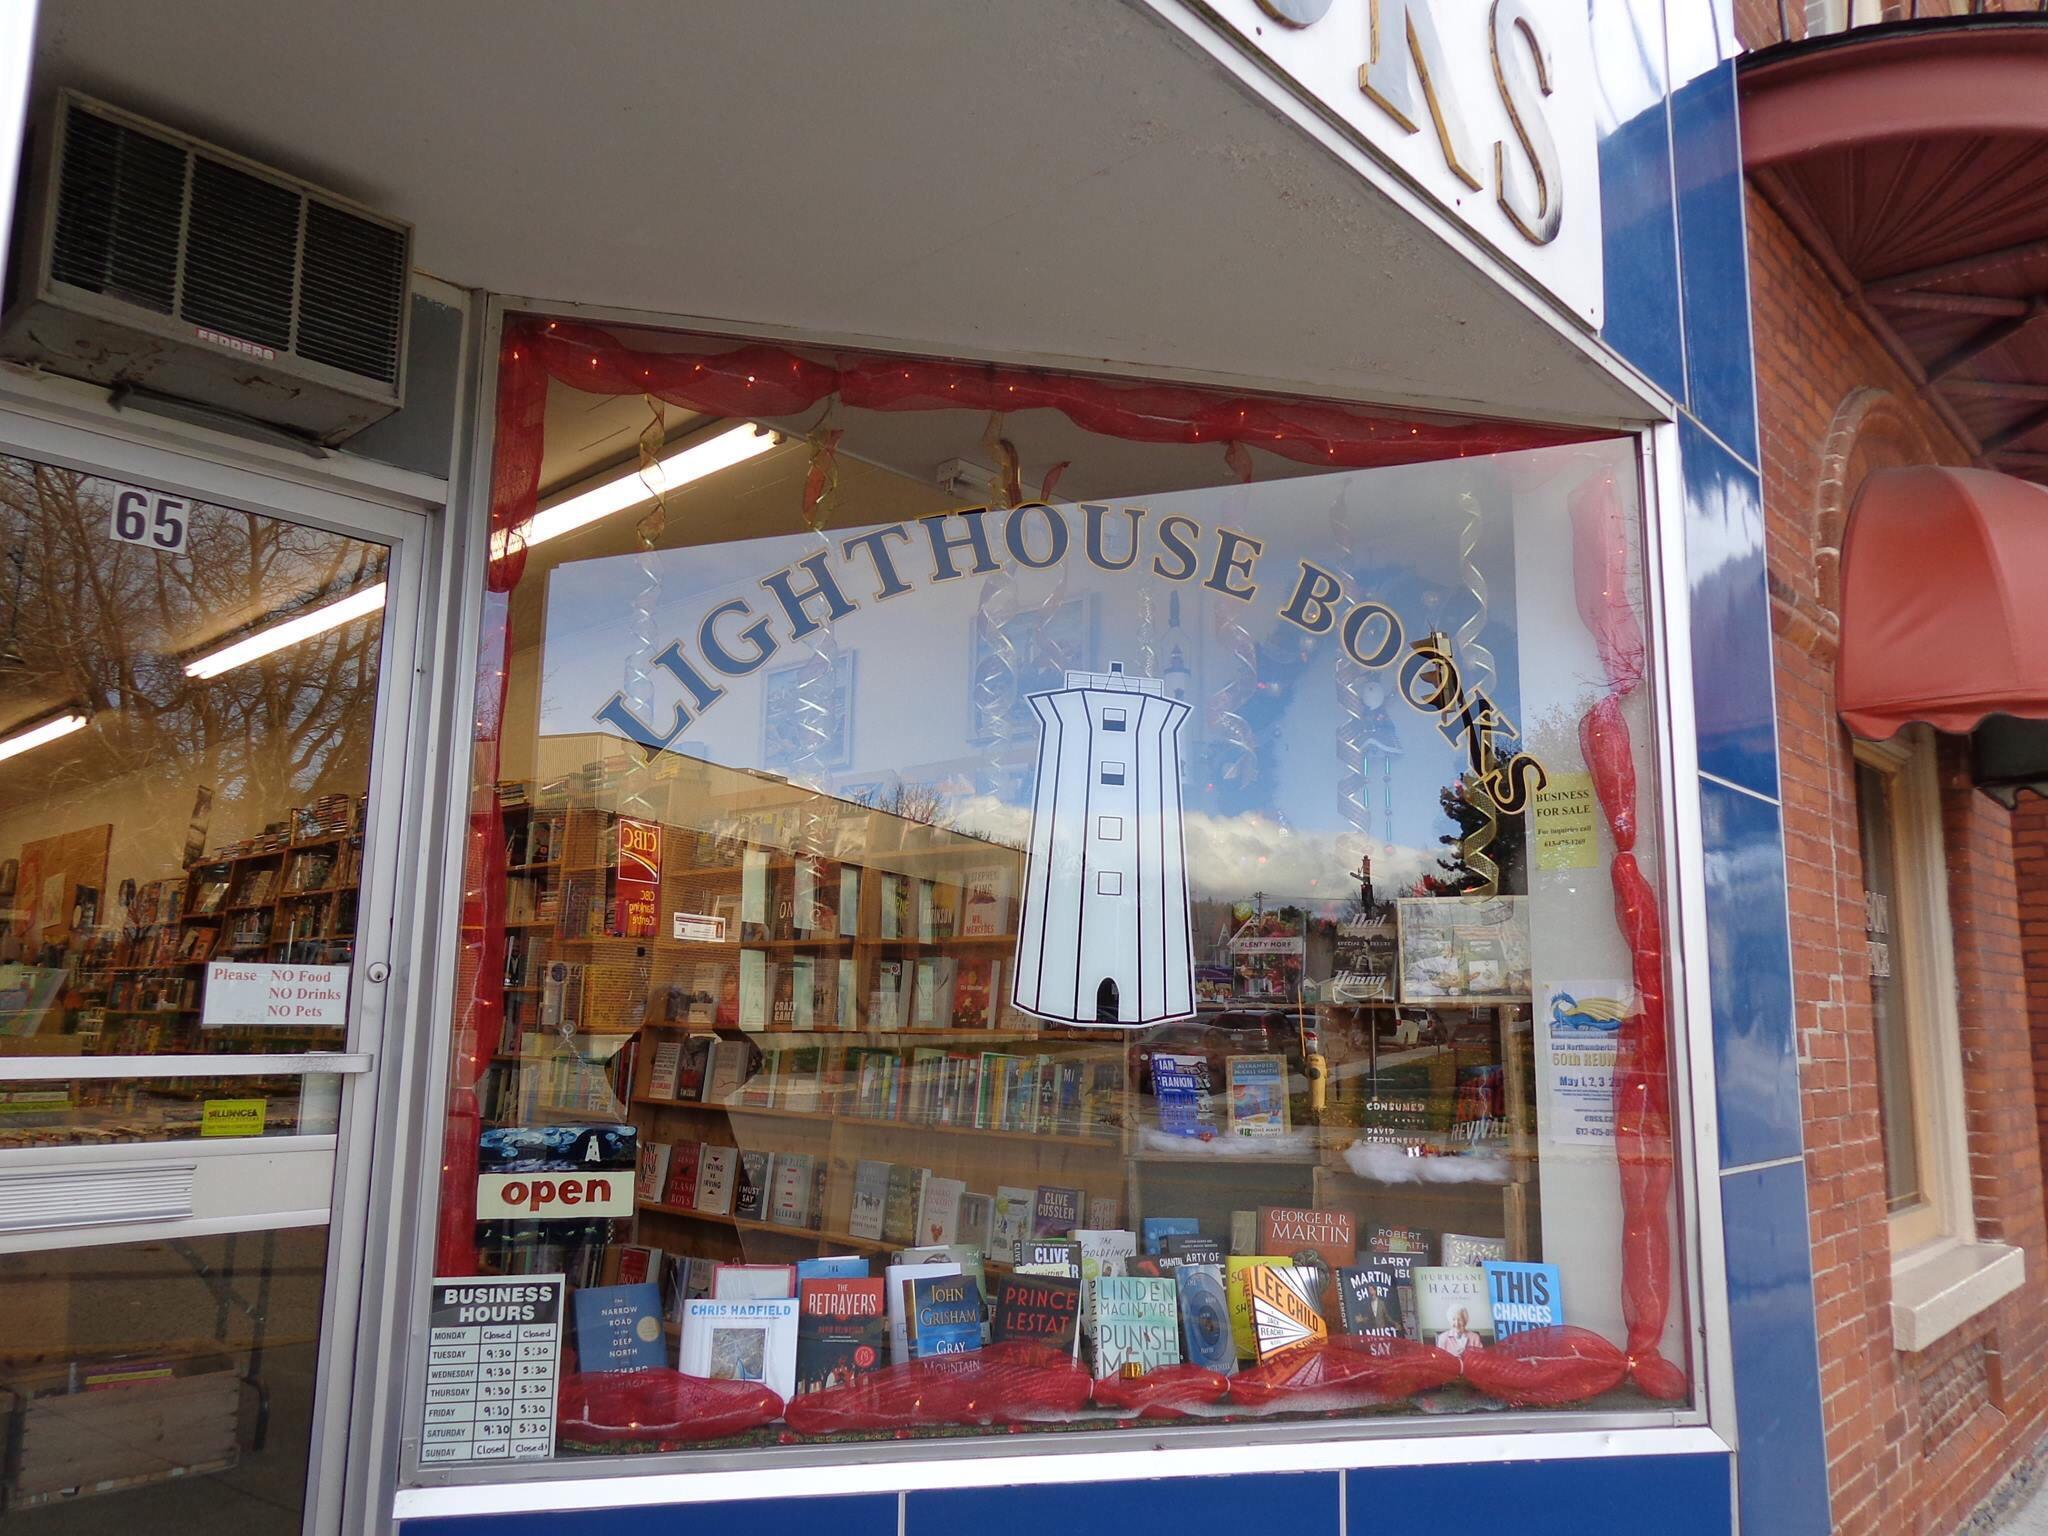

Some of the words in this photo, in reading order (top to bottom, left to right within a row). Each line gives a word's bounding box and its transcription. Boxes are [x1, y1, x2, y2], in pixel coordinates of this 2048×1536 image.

[1252, 0, 1563, 246] KS
[197, 329, 274, 360] FEDDERS
[116, 491, 183, 548] 65
[593, 500, 1264, 766] LIGHTHOUSE
[1279, 558, 1548, 815] BOOKS
[1536, 789, 1590, 802] BUSINESS
[1536, 807, 1559, 817] FOR
[1562, 804, 1591, 815] SALE
[974, 883, 993, 896] KING
[213, 968, 257, 981] Please
[270, 969, 294, 982] NO
[299, 970, 331, 983] Food
[1334, 970, 1386, 989] Young
[269, 987, 292, 999] NO
[296, 988, 341, 1000] Drinks
[267, 1005, 290, 1017] NO
[295, 1005, 322, 1017] Pets
[1159, 1060, 1174, 1071] IAN
[1552, 1053, 1581, 1066] 60th
[1161, 1076, 1194, 1088] RANKIN
[1559, 1076, 1579, 1087] May
[1366, 1102, 1425, 1111] CONSUMED
[1366, 1127, 1395, 1135] DAVID
[1451, 1118, 1510, 1141] REVIVAL
[704, 1163, 724, 1172] IRVING
[671, 1180, 695, 1192] FLASH
[703, 1179, 721, 1189] IRVING
[742, 1185, 760, 1195] MUST
[501, 1178, 611, 1212] open
[671, 1194, 691, 1205] BOYS
[742, 1194, 754, 1202] SAY
[1045, 1191, 1069, 1206] CLIVE
[1038, 1203, 1075, 1220] CUSSLER
[1270, 1209, 1320, 1224] GEORGE
[1272, 1222, 1350, 1243] MARTIN
[1378, 1228, 1422, 1240] ROBERT
[1370, 1237, 1429, 1251] GALAITH
[1034, 1247, 1070, 1263] CLIVE
[1185, 1252, 1207, 1263] ARTY
[1209, 1252, 1220, 1262] OF
[1373, 1256, 1412, 1267] LARRY
[1350, 1270, 1392, 1289] MARTIN
[837, 1283, 848, 1291] THE
[1100, 1280, 1174, 1300] LINDEN
[1356, 1286, 1389, 1301] SHRT
[1428, 1283, 1479, 1294] HAZEL
[1491, 1270, 1550, 1305] THIS
[444, 1286, 553, 1305] BUSINESS
[931, 1285, 964, 1304] JOHN
[1005, 1286, 1078, 1311] PRINCE
[1253, 1265, 1284, 1308] LEE
[1287, 1293, 1319, 1332] CHILD
[601, 1306, 638, 1315] NARROW
[691, 1304, 727, 1316] CHRIS
[731, 1304, 791, 1316] HADFIELD
[808, 1292, 877, 1315] BETRAYERS
[1100, 1302, 1174, 1317] MACINTYRE
[459, 1305, 535, 1323] HOURS
[920, 1308, 976, 1326] GRISHAM
[1493, 1303, 1552, 1323] CHANGES
[609, 1318, 632, 1326] ROAD
[1006, 1312, 1070, 1333] LESTAT
[434, 1331, 466, 1341] MONDAY
[483, 1330, 512, 1340] Closed
[522, 1329, 551, 1338] Closed
[1101, 1325, 1177, 1350] PUNISH
[1365, 1326, 1398, 1342] MUST
[612, 1338, 632, 1346] DEEP
[936, 1340, 966, 1355] GRAY
[1370, 1342, 1392, 1356] SAY
[432, 1350, 466, 1359] TUESDAY
[486, 1349, 511, 1359] 9:30
[523, 1347, 549, 1356] 5:30
[609, 1348, 638, 1358] NORTH
[431, 1369, 474, 1379] WEDNESDAY
[486, 1367, 511, 1377] 9:30
[522, 1365, 547, 1375] 5:30
[924, 1360, 980, 1376] MOUNTAIN
[430, 1388, 470, 1397] THURSDAY
[484, 1386, 511, 1396] 9:30
[521, 1385, 546, 1394] 5:30
[428, 1408, 456, 1417] FRIDAY
[483, 1405, 510, 1416] 9:30
[520, 1404, 546, 1414] 5:30
[426, 1428, 466, 1438] SATURDAY
[483, 1424, 511, 1435] 9:30
[519, 1423, 547, 1433] 5:30
[425, 1448, 456, 1457] SUNDAY
[476, 1444, 505, 1455] Closed
